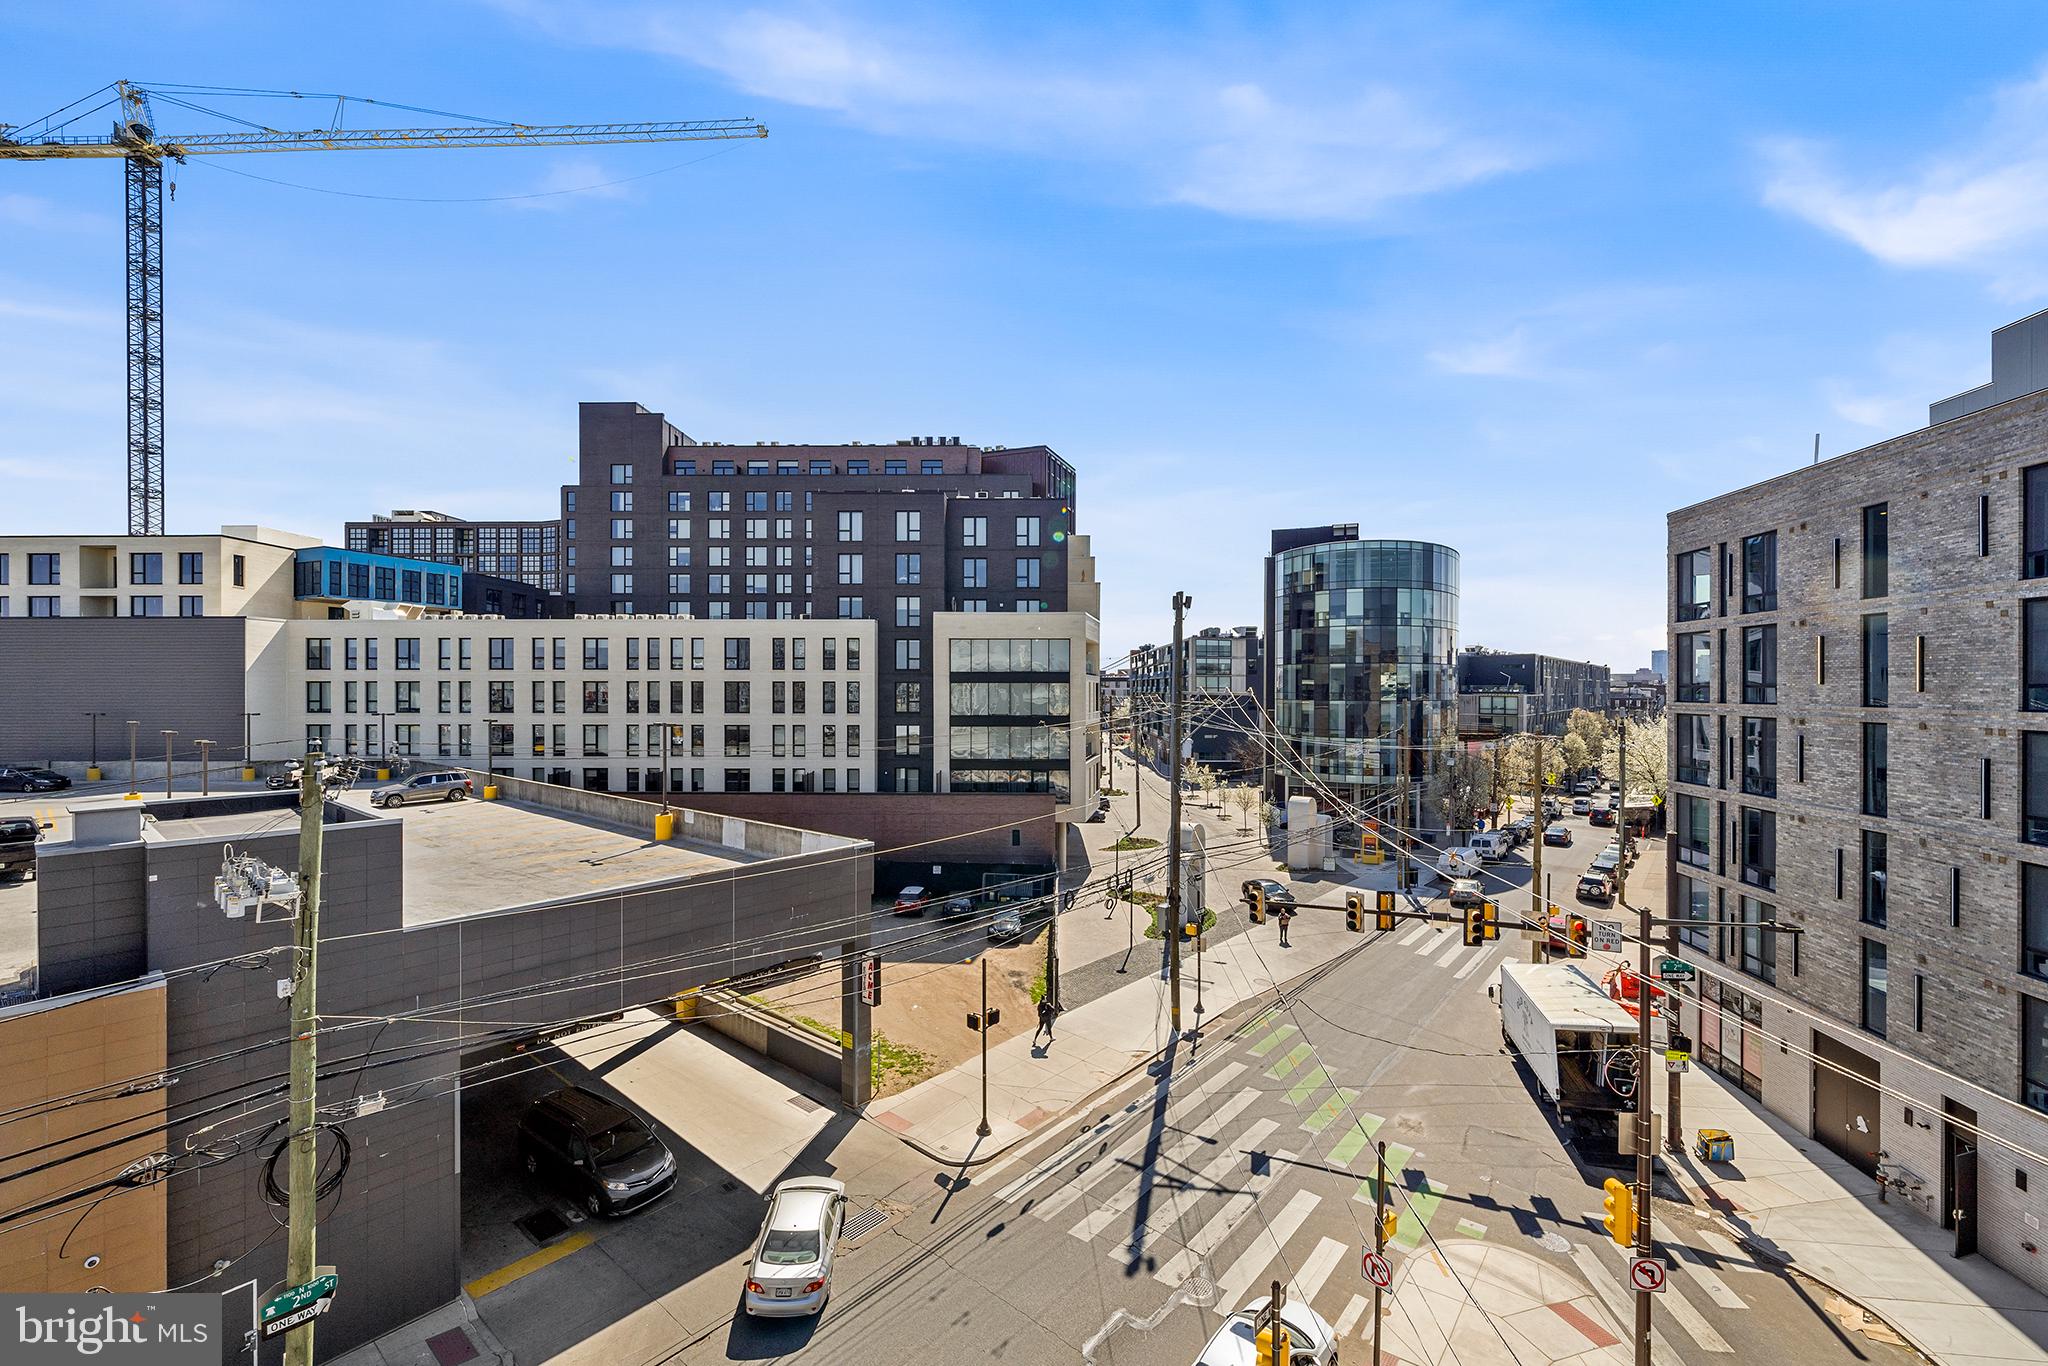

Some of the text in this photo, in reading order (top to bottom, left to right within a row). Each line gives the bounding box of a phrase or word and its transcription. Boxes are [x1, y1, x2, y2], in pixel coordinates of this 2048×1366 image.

[1599, 923, 1615, 932] NO
[537, 1021, 603, 1045] DO NOT ENTER
[292, 1278, 335, 1309] 2ND ST
[299, 1286, 305, 1294] N
[270, 1305, 317, 1332] ONE WAY
